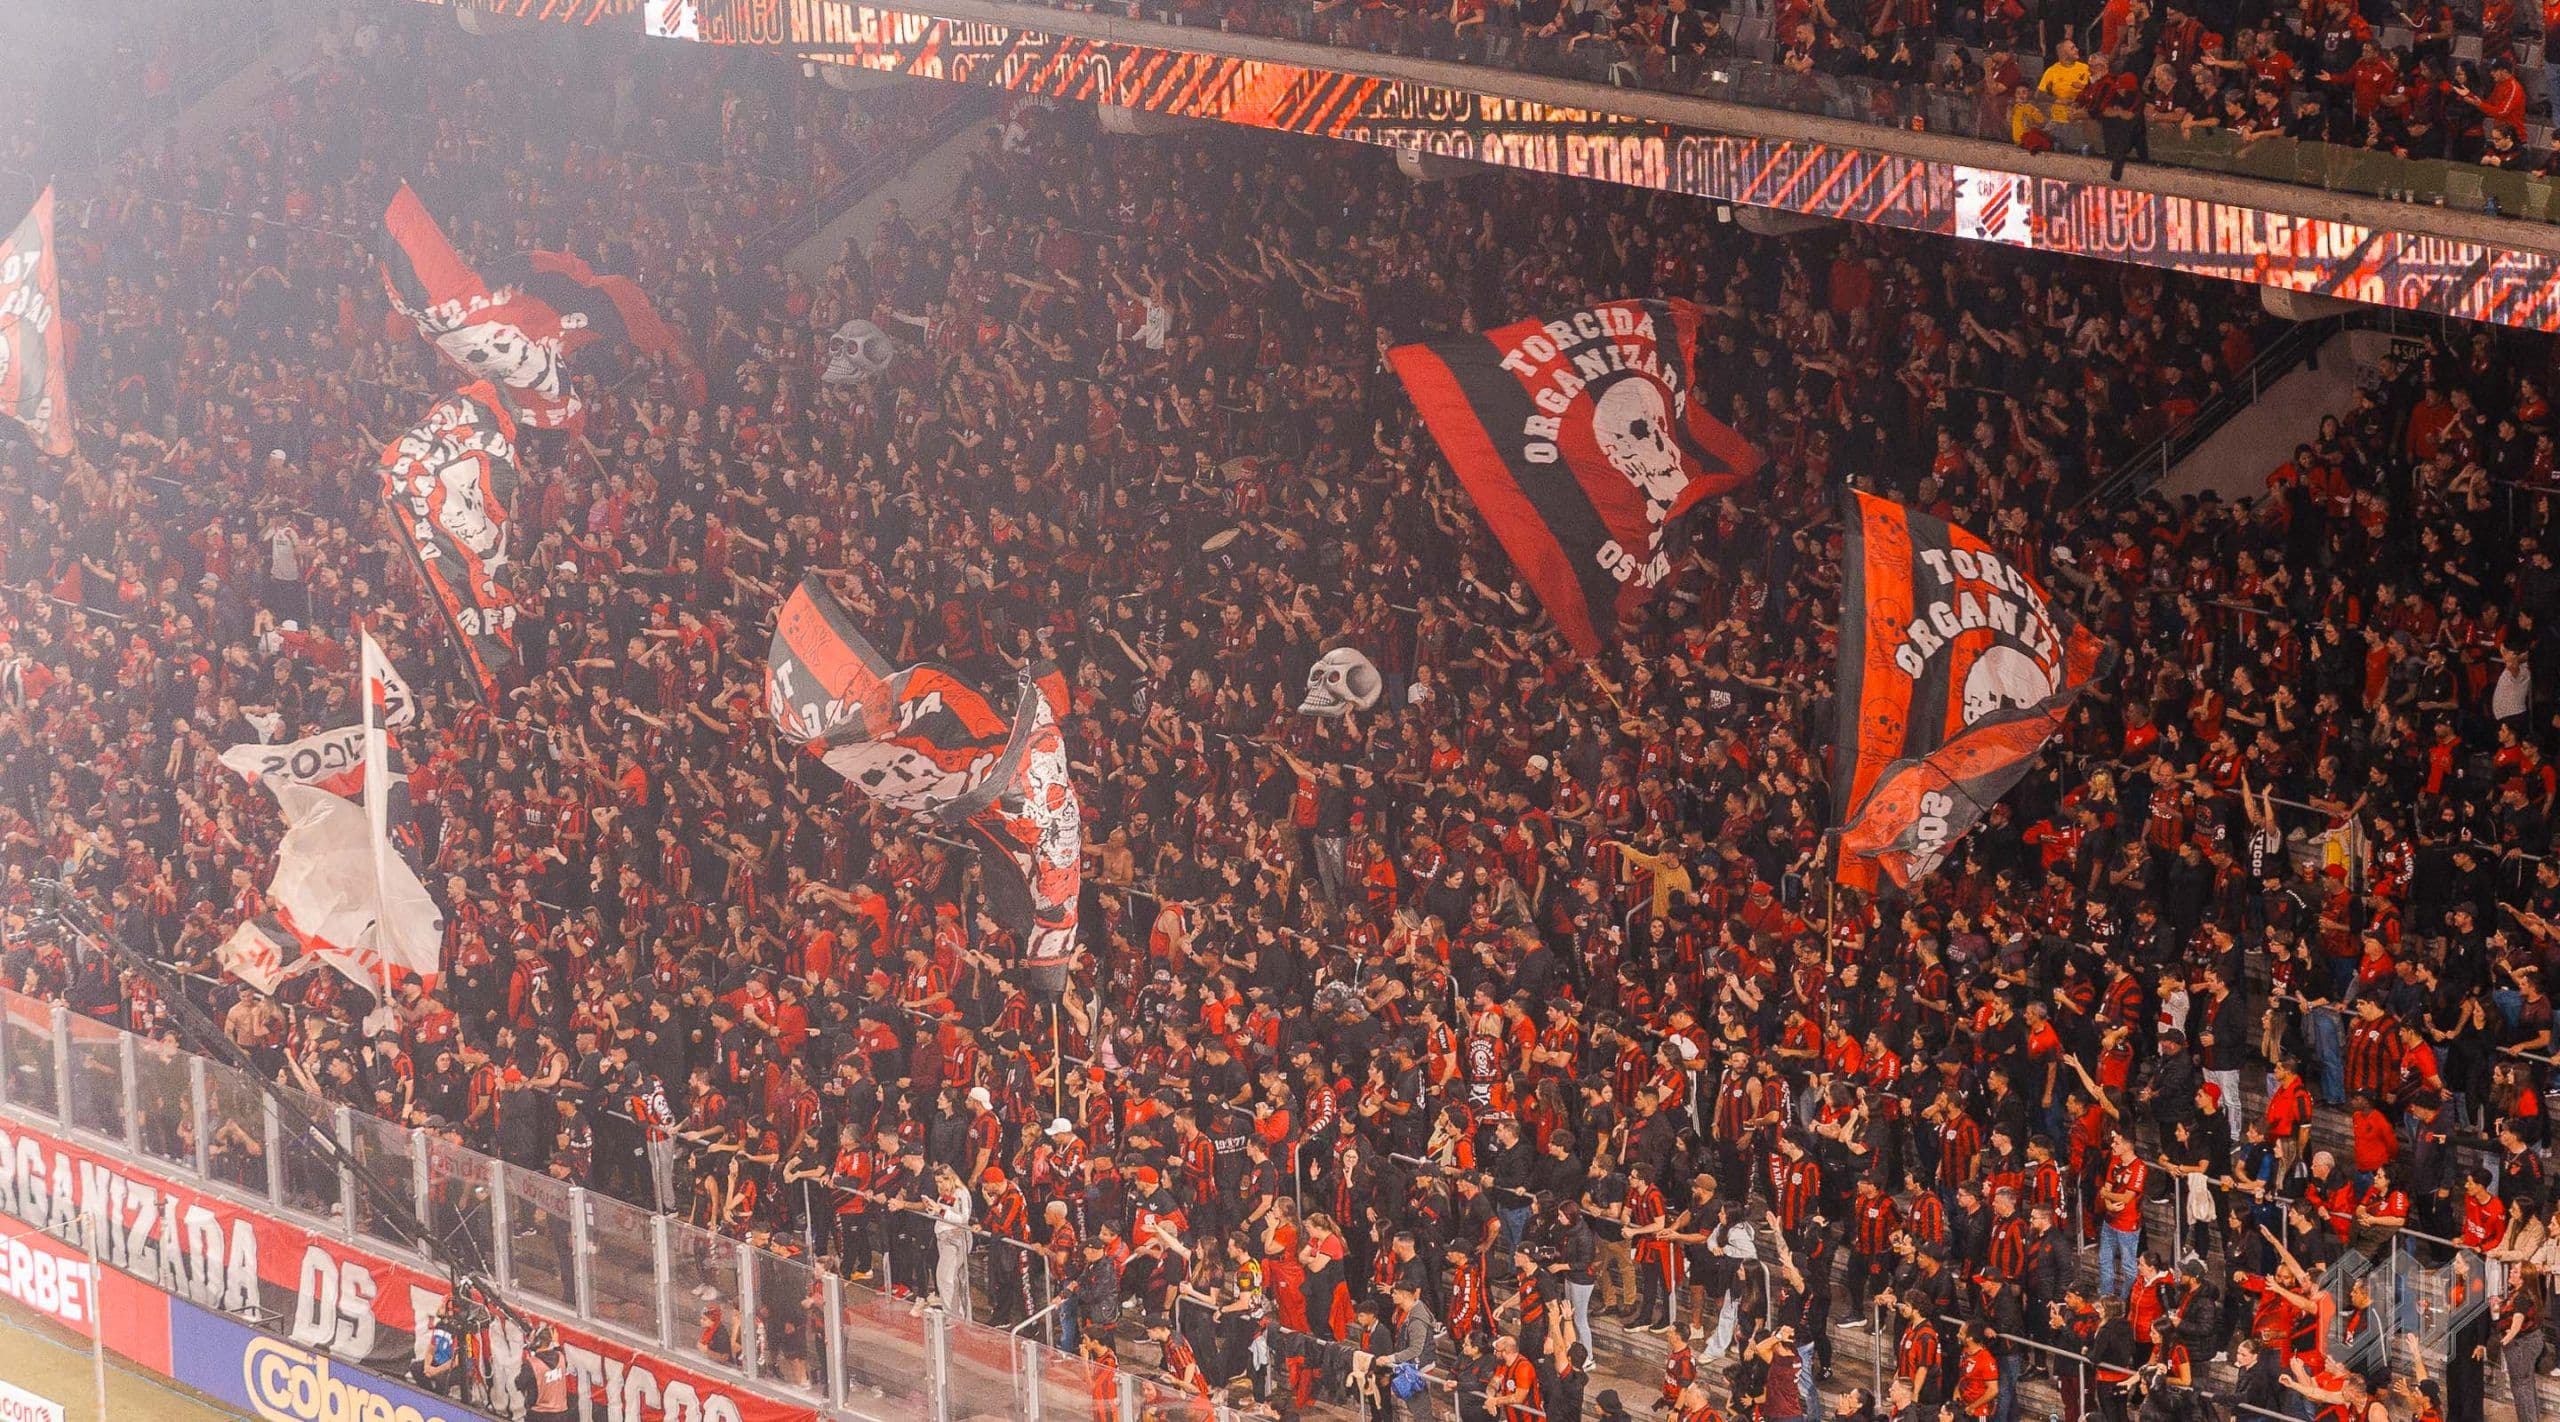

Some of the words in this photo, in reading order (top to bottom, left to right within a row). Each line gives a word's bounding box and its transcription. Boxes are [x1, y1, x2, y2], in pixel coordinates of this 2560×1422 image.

[1500, 307, 1656, 377] TORCIDA
[1524, 344, 1686, 464] ORGANIZADA
[290, 1244, 377, 1363] OS
